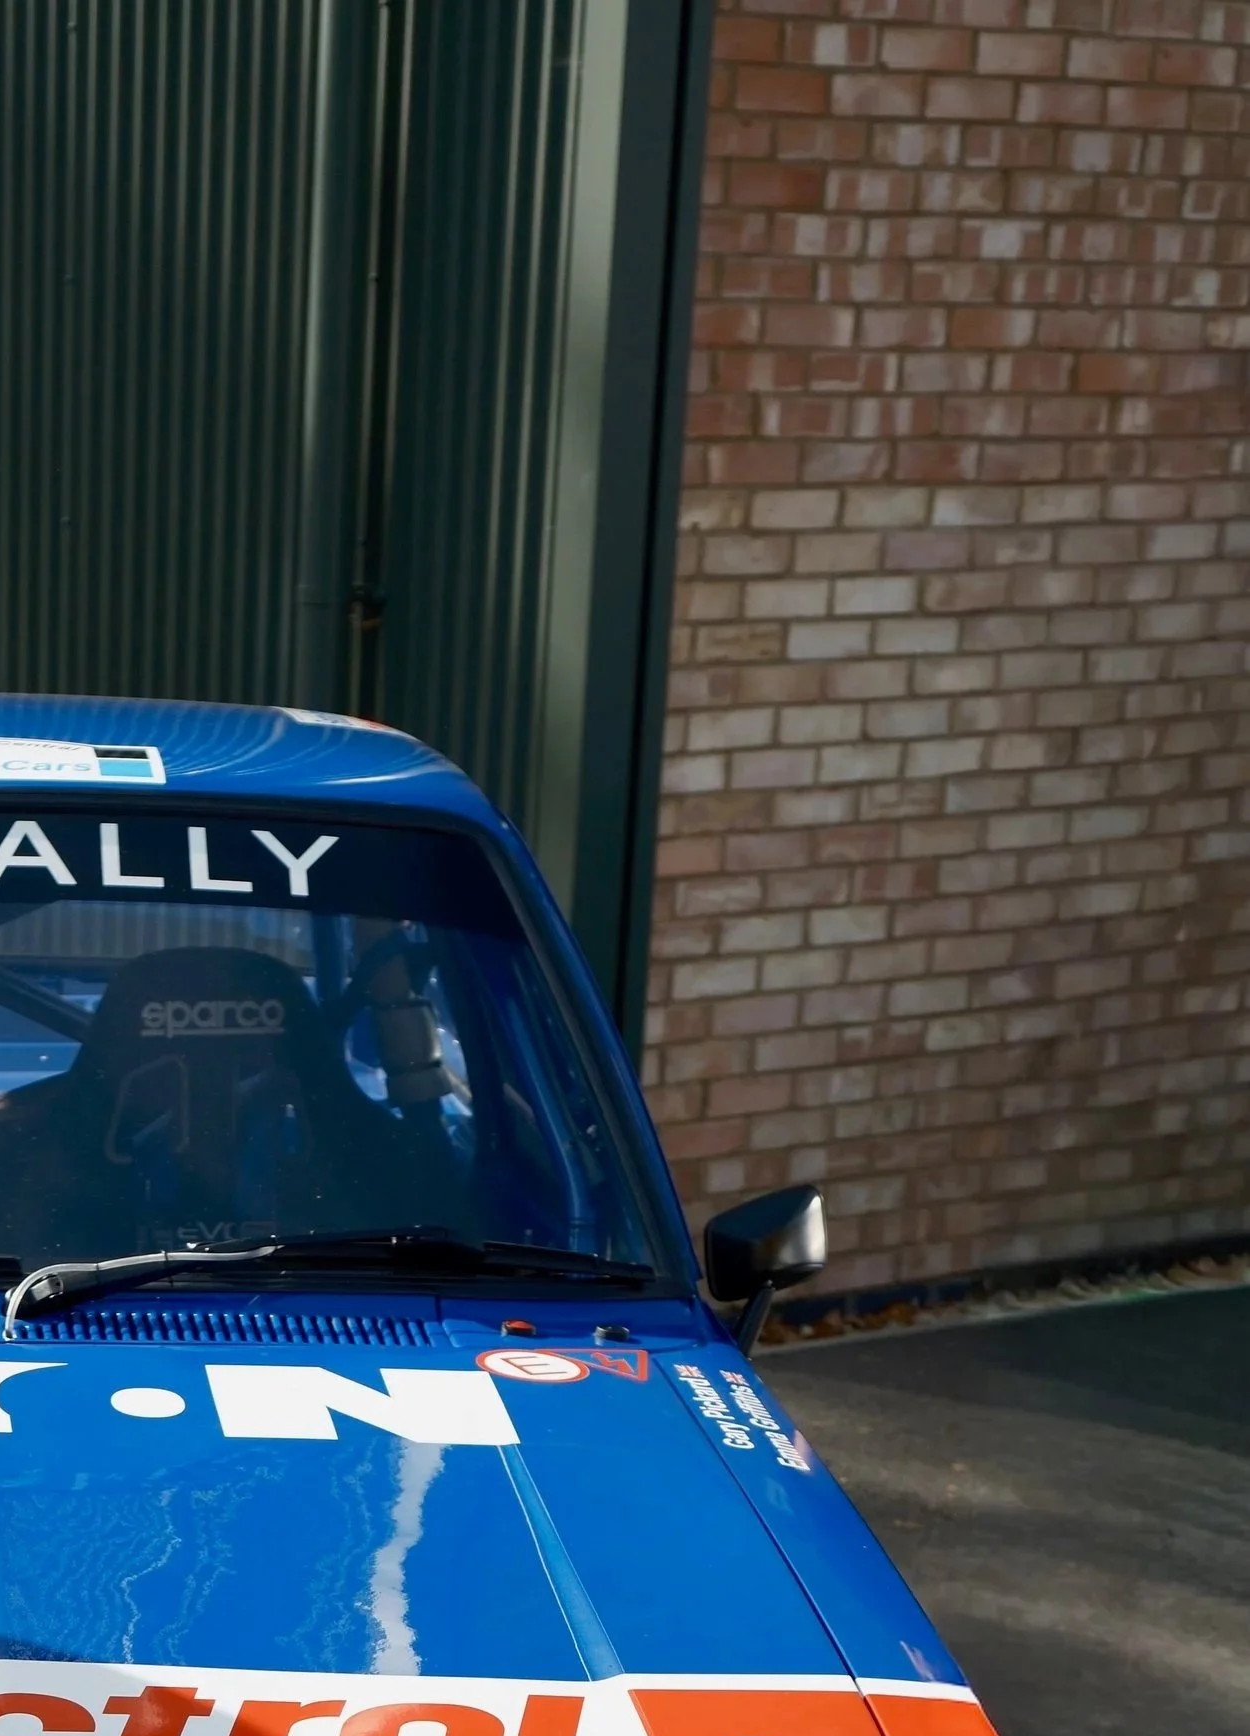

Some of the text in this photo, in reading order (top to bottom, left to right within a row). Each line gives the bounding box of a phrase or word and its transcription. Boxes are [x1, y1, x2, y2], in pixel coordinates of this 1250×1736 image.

[2, 759, 93, 772] Cars
[140, 998, 285, 1038] sparco
[678, 1376, 755, 1450] Gary Pickard
[764, 1430, 811, 1471] Emma
